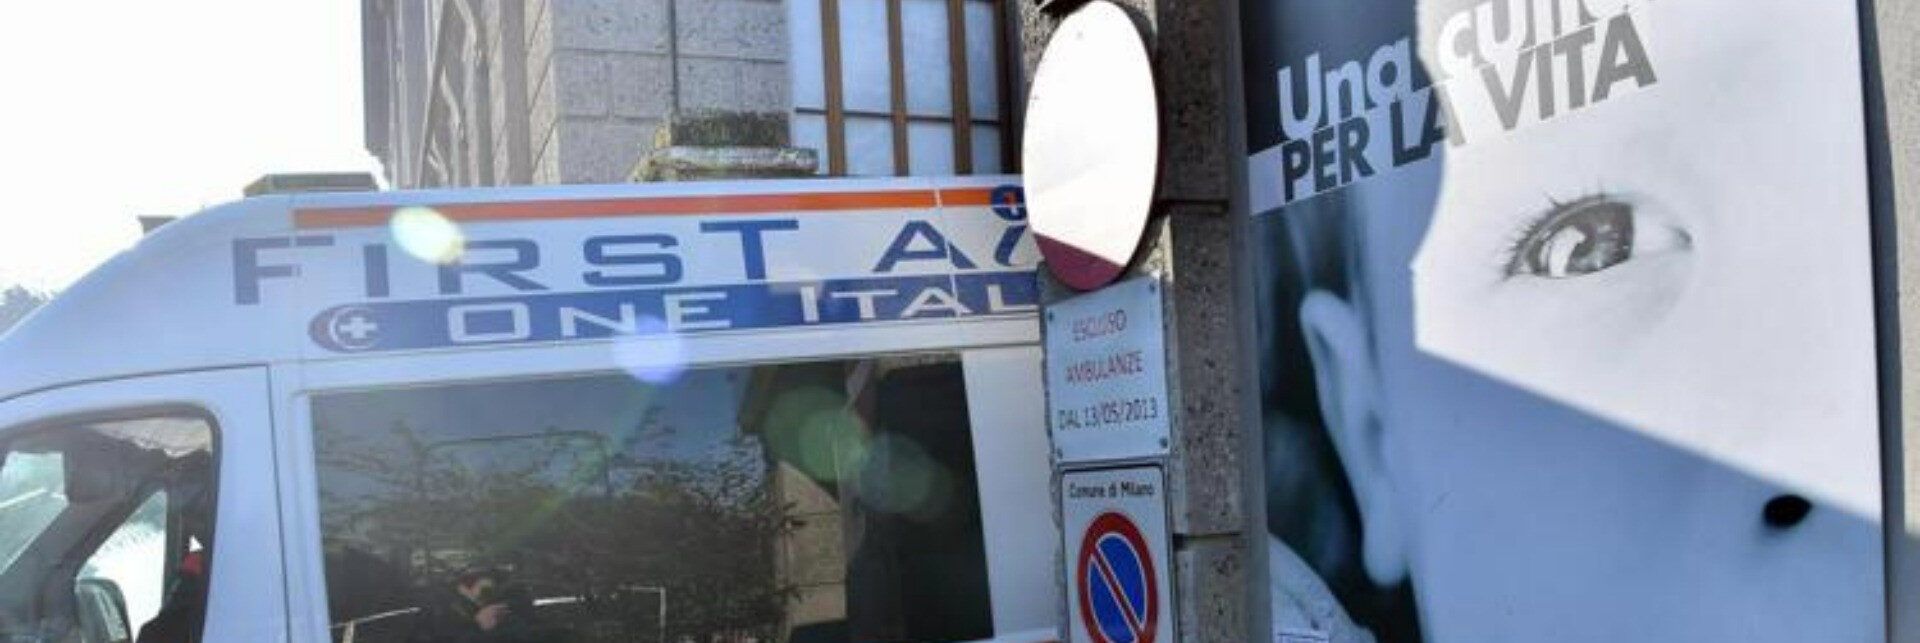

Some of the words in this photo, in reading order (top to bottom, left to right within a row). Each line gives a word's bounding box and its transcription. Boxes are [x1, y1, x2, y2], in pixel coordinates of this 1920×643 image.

[1276, 37, 1413, 140] Una
[1282, 116, 1375, 203] PER
[1390, 86, 1465, 168] LA
[1480, 13, 1657, 130] VITA
[232, 218, 799, 306] FIRST
[448, 290, 732, 344] ONE
[800, 282, 1040, 323] ITAL
[1065, 351, 1143, 382] AMBULANZE
[1058, 408, 1081, 429] DAL
[1084, 396, 1158, 428] 13/05/2013
[1070, 481, 1105, 498] Comune
[1109, 483, 1117, 498] di
[1121, 480, 1154, 497] Milano
